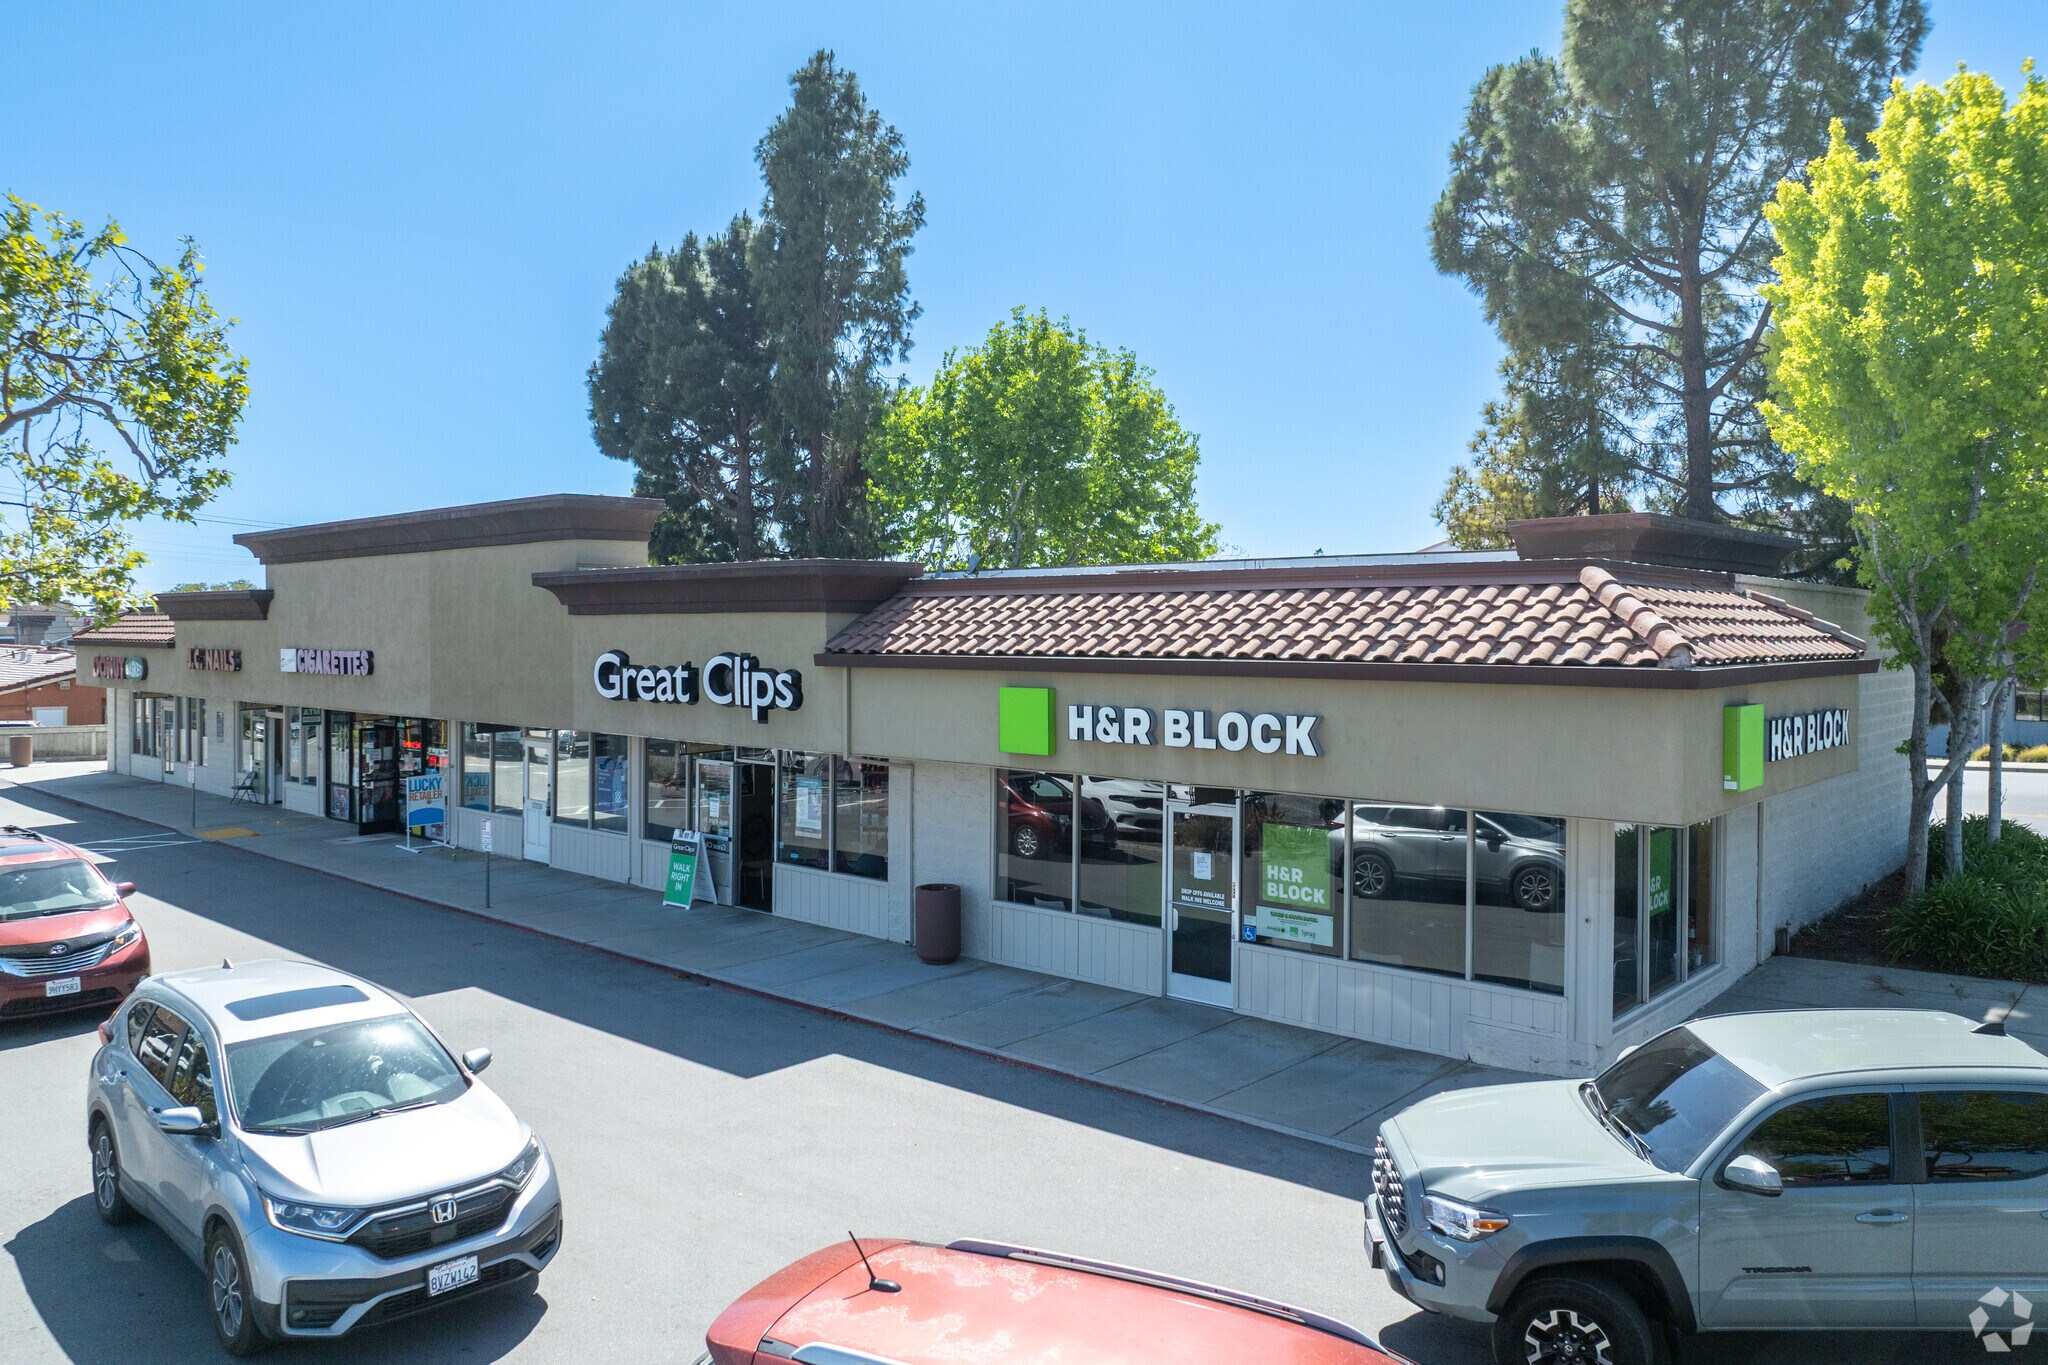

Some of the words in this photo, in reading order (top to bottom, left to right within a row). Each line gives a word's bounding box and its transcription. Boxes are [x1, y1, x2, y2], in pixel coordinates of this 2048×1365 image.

[204, 649, 235, 672] NAILS
[297, 649, 369, 676] CIGARETTES
[594, 652, 690, 703] Great
[702, 655, 794, 721] Clips
[303, 708, 320, 716] ATM
[1068, 705, 1151, 746] H&R
[1164, 709, 1318, 757] BLOCK
[1771, 716, 1803, 762] H&R
[1807, 709, 1850, 754] BLOCK
[409, 777, 442, 792] LUCKY
[409, 790, 442, 801] RETAILER
[673, 862, 691, 872] WALK
[1267, 864, 1303, 884] H&R
[671, 871, 690, 882] RIGHT
[1649, 875, 1661, 892] &R
[675, 882, 682, 891] IN
[1267, 881, 1325, 904] BLOCK
[1203, 898, 1225, 907] WELCOME
[1648, 889, 1669, 910] LOCK
[48, 983, 79, 995] 9HYY583
[431, 1265, 476, 1291] 8VZW142
